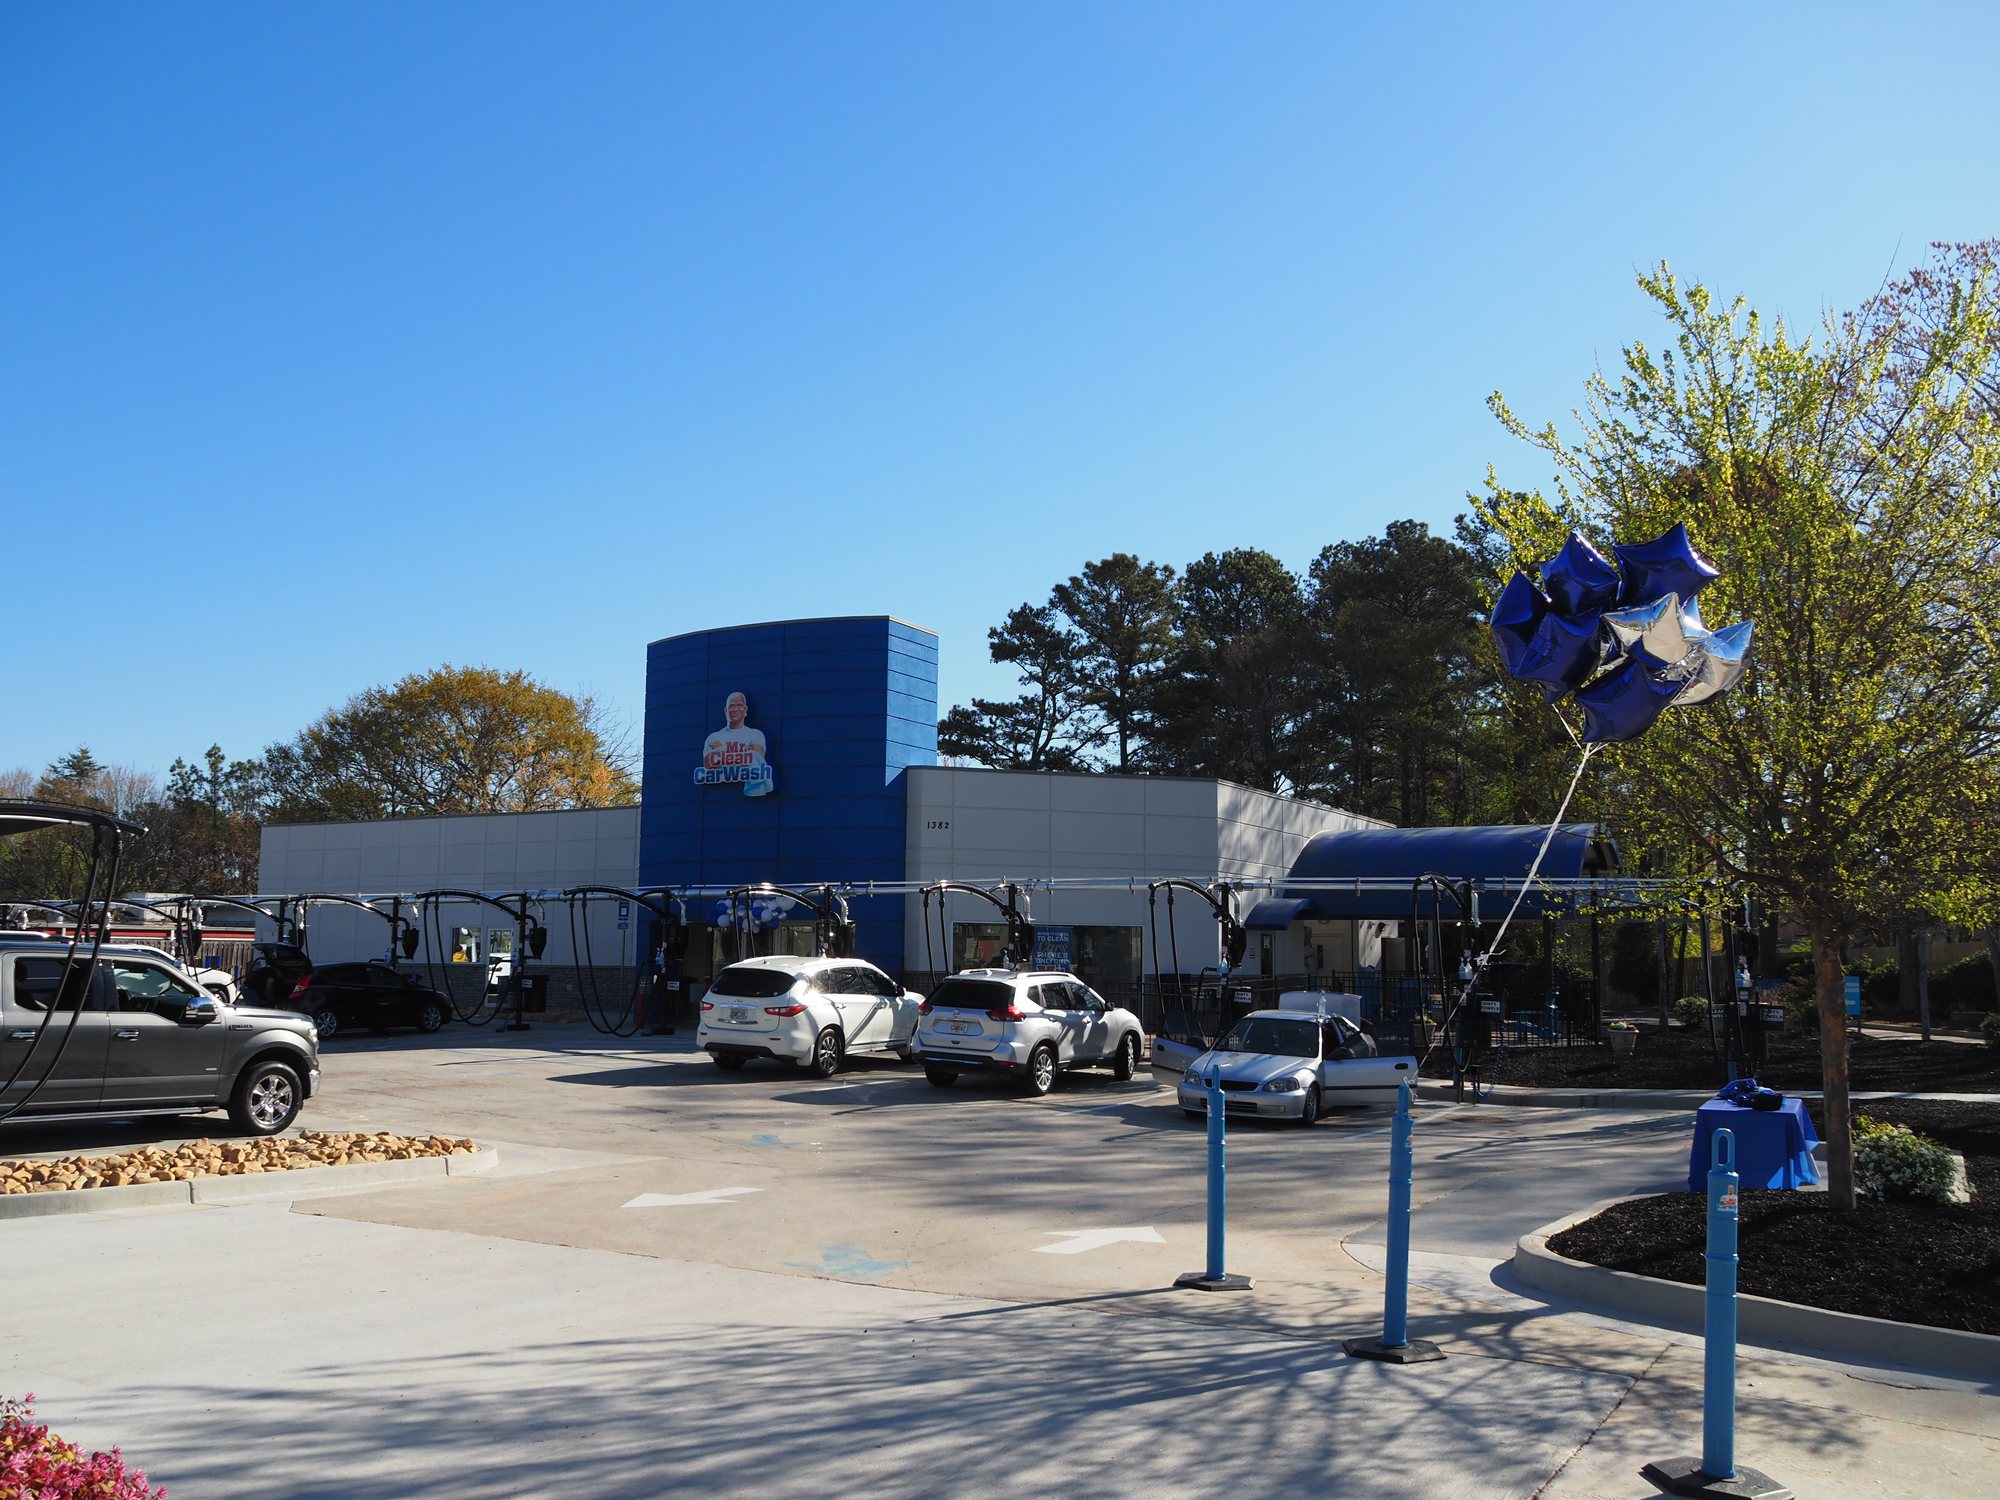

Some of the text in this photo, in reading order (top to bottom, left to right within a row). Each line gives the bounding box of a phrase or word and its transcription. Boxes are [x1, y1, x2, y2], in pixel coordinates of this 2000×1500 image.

[726, 741, 748, 753] Mr.
[710, 751, 753, 766] Clean
[694, 763, 771, 782] CarWash
[927, 821, 949, 830] 1382
